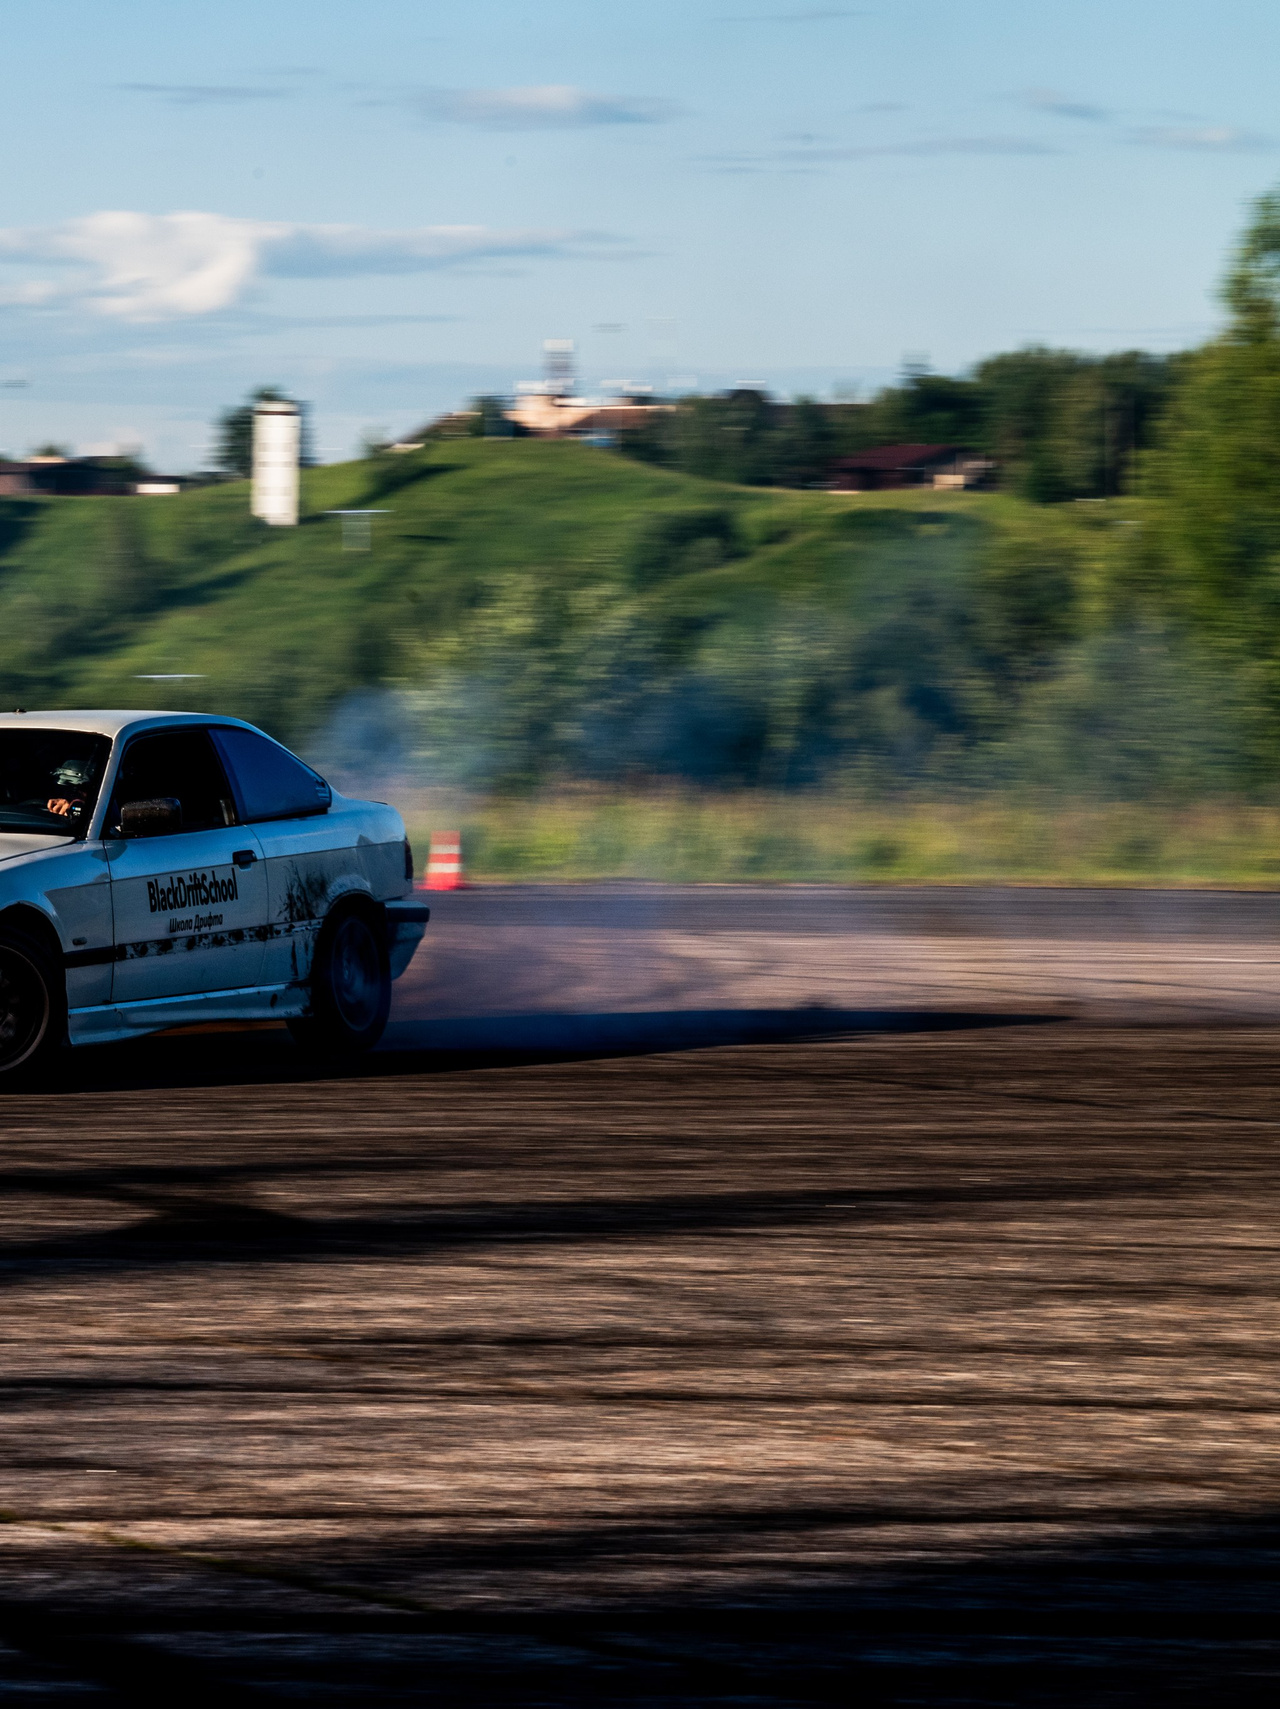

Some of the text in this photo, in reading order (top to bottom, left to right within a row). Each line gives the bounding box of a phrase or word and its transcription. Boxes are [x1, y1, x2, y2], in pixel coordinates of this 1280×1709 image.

[147, 868, 238, 912] BlackDriftSchool
[170, 913, 223, 932] Школа Дрифта
